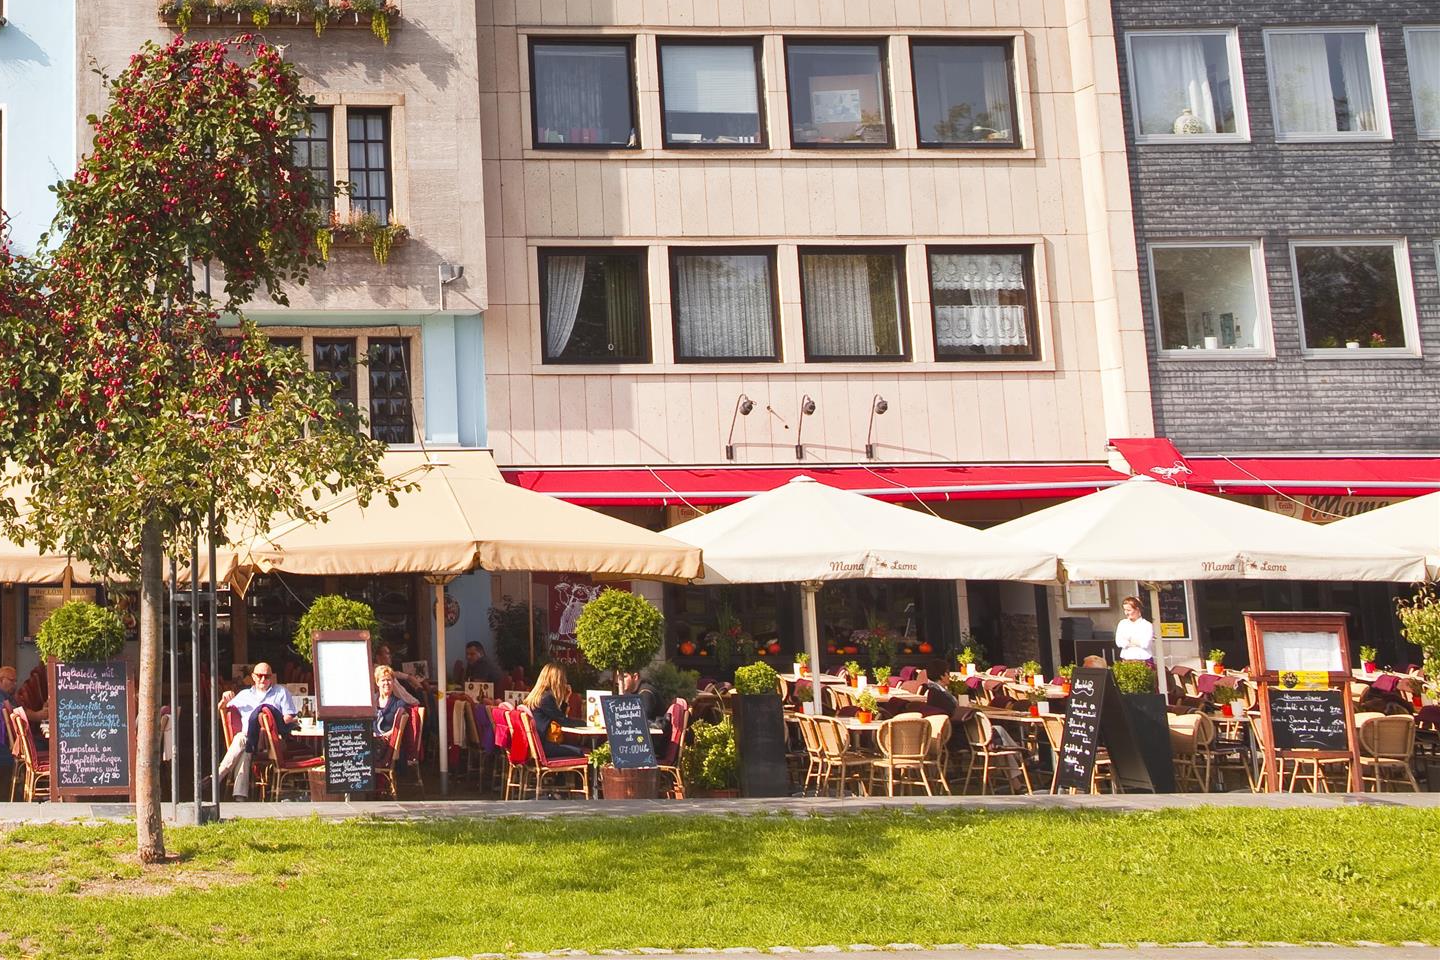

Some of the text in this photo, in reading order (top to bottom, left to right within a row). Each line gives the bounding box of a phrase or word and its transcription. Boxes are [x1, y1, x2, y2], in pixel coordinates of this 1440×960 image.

[830, 561, 864, 571] Mama
[1201, 560, 1288, 572] Mama Leone
[59, 741, 100, 757] Rumpsteak
[76, 764, 103, 773] Pommes
[61, 773, 87, 784] Salat
